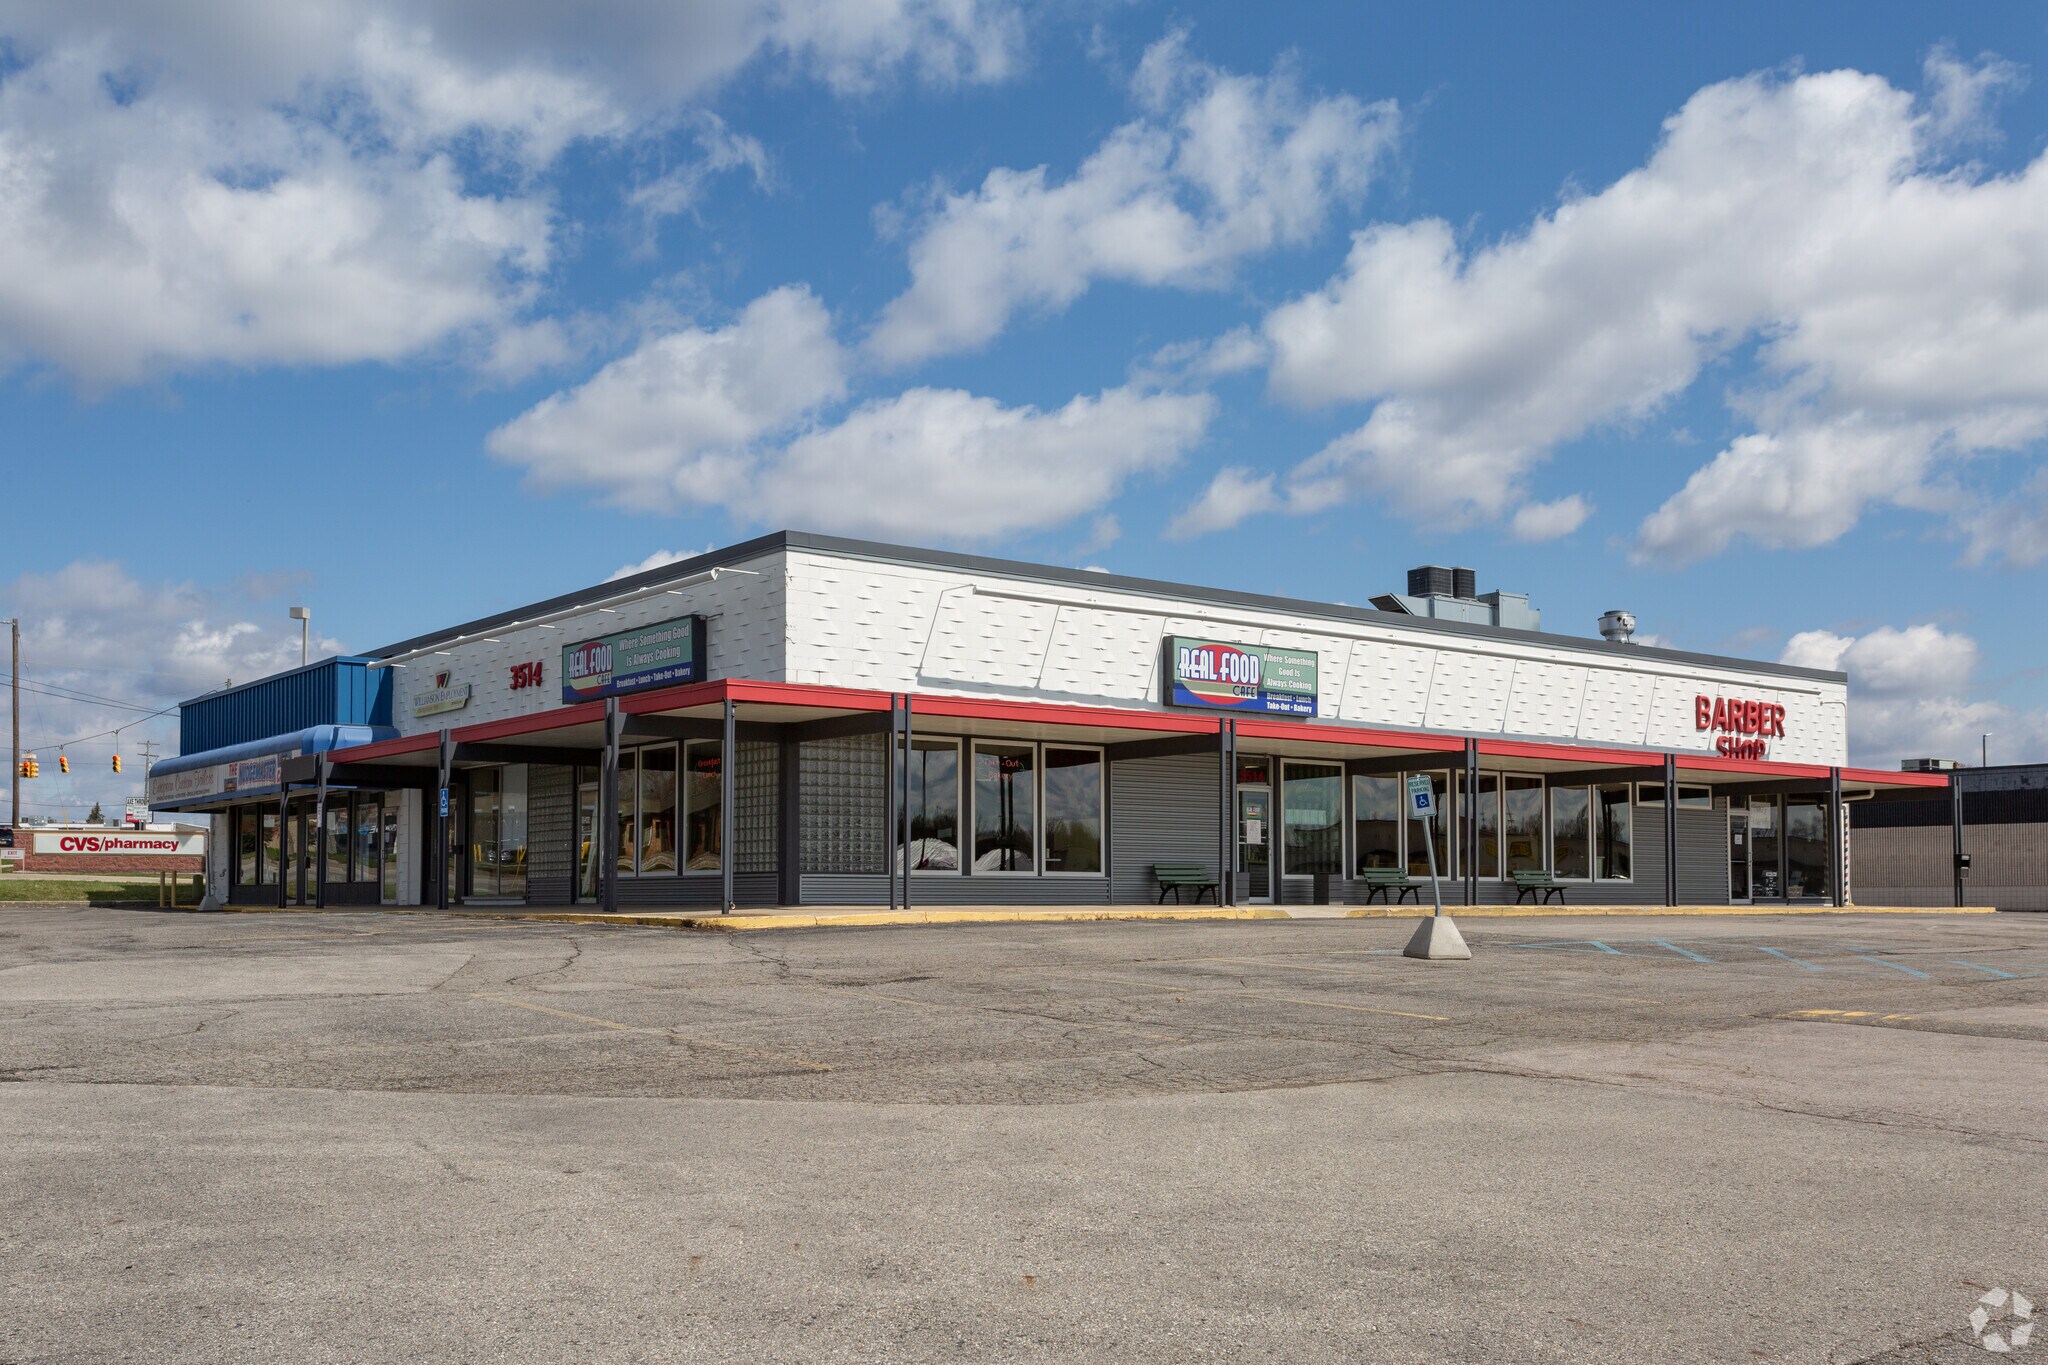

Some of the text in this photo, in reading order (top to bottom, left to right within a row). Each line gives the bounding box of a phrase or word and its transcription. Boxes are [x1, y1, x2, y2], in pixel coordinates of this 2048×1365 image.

[619, 624, 689, 651] Where Something Good
[568, 644, 613, 679] REAL FOOD
[626, 645, 681, 667] Is Always Cooking
[1263, 653, 1315, 668] Where Something
[1178, 647, 1261, 685] REAL FOOD
[1278, 667, 1301, 678] Good Is
[510, 662, 543, 690] 3514
[597, 672, 612, 685] CAFE
[616, 667, 691, 688] Breakfast Lunch Take-Out Bakery
[1266, 678, 1312, 691] Always Cooking
[1232, 685, 1256, 698] CAFE
[1266, 692, 1312, 703] Breakfast Lunch
[1266, 702, 1312, 714] Take-Out Bakery
[1695, 695, 1785, 738] BARBER
[1715, 735, 1766, 760] SHOP
[60, 836, 180, 852] CVS/pharmacy
